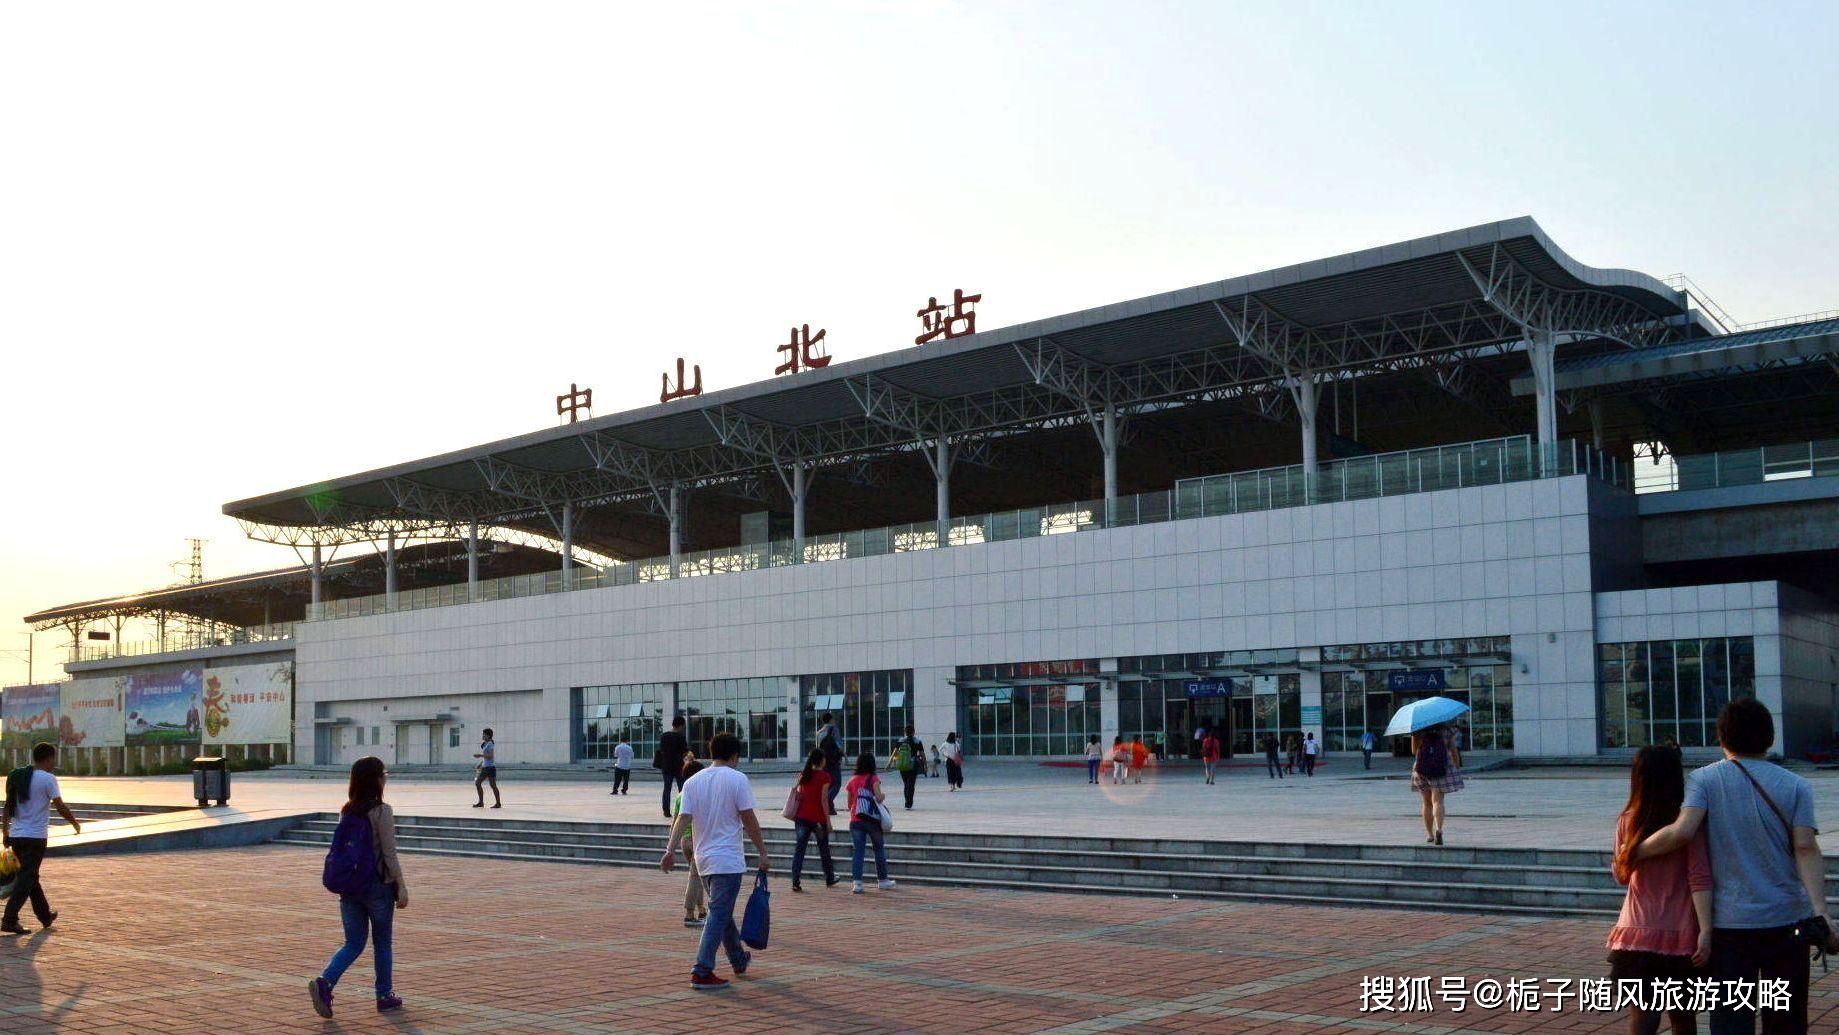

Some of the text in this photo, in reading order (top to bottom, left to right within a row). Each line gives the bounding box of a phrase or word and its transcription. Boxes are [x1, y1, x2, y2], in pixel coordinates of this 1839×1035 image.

[556, 288, 982, 422] 中山北站
[1427, 673, 1437, 686] A
[1217, 681, 1226, 693] A
